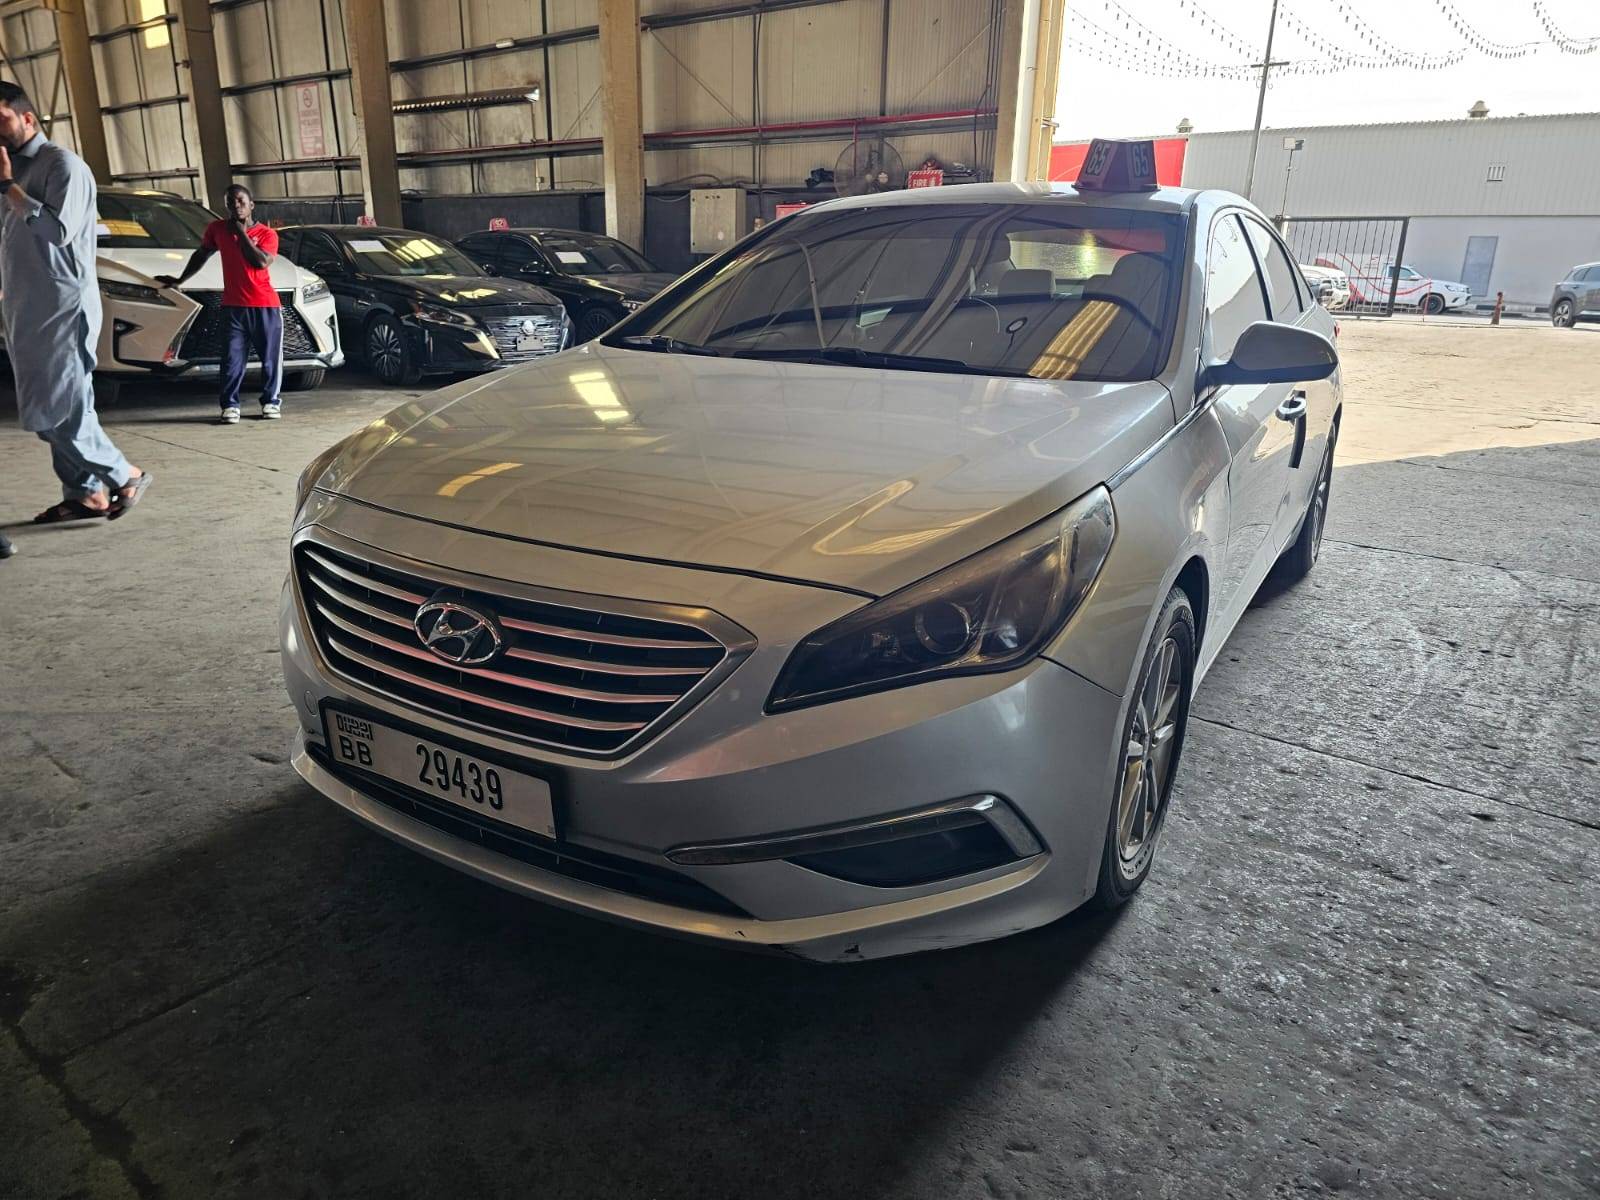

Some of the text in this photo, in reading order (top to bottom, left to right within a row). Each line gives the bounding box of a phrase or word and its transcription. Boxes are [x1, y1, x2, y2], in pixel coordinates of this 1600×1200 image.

[1087, 142, 1111, 176] 65
[1132, 144, 1149, 177] 65
[912, 178, 928, 188] FIRE
[341, 735, 372, 765] BB
[416, 743, 504, 811] 29439
